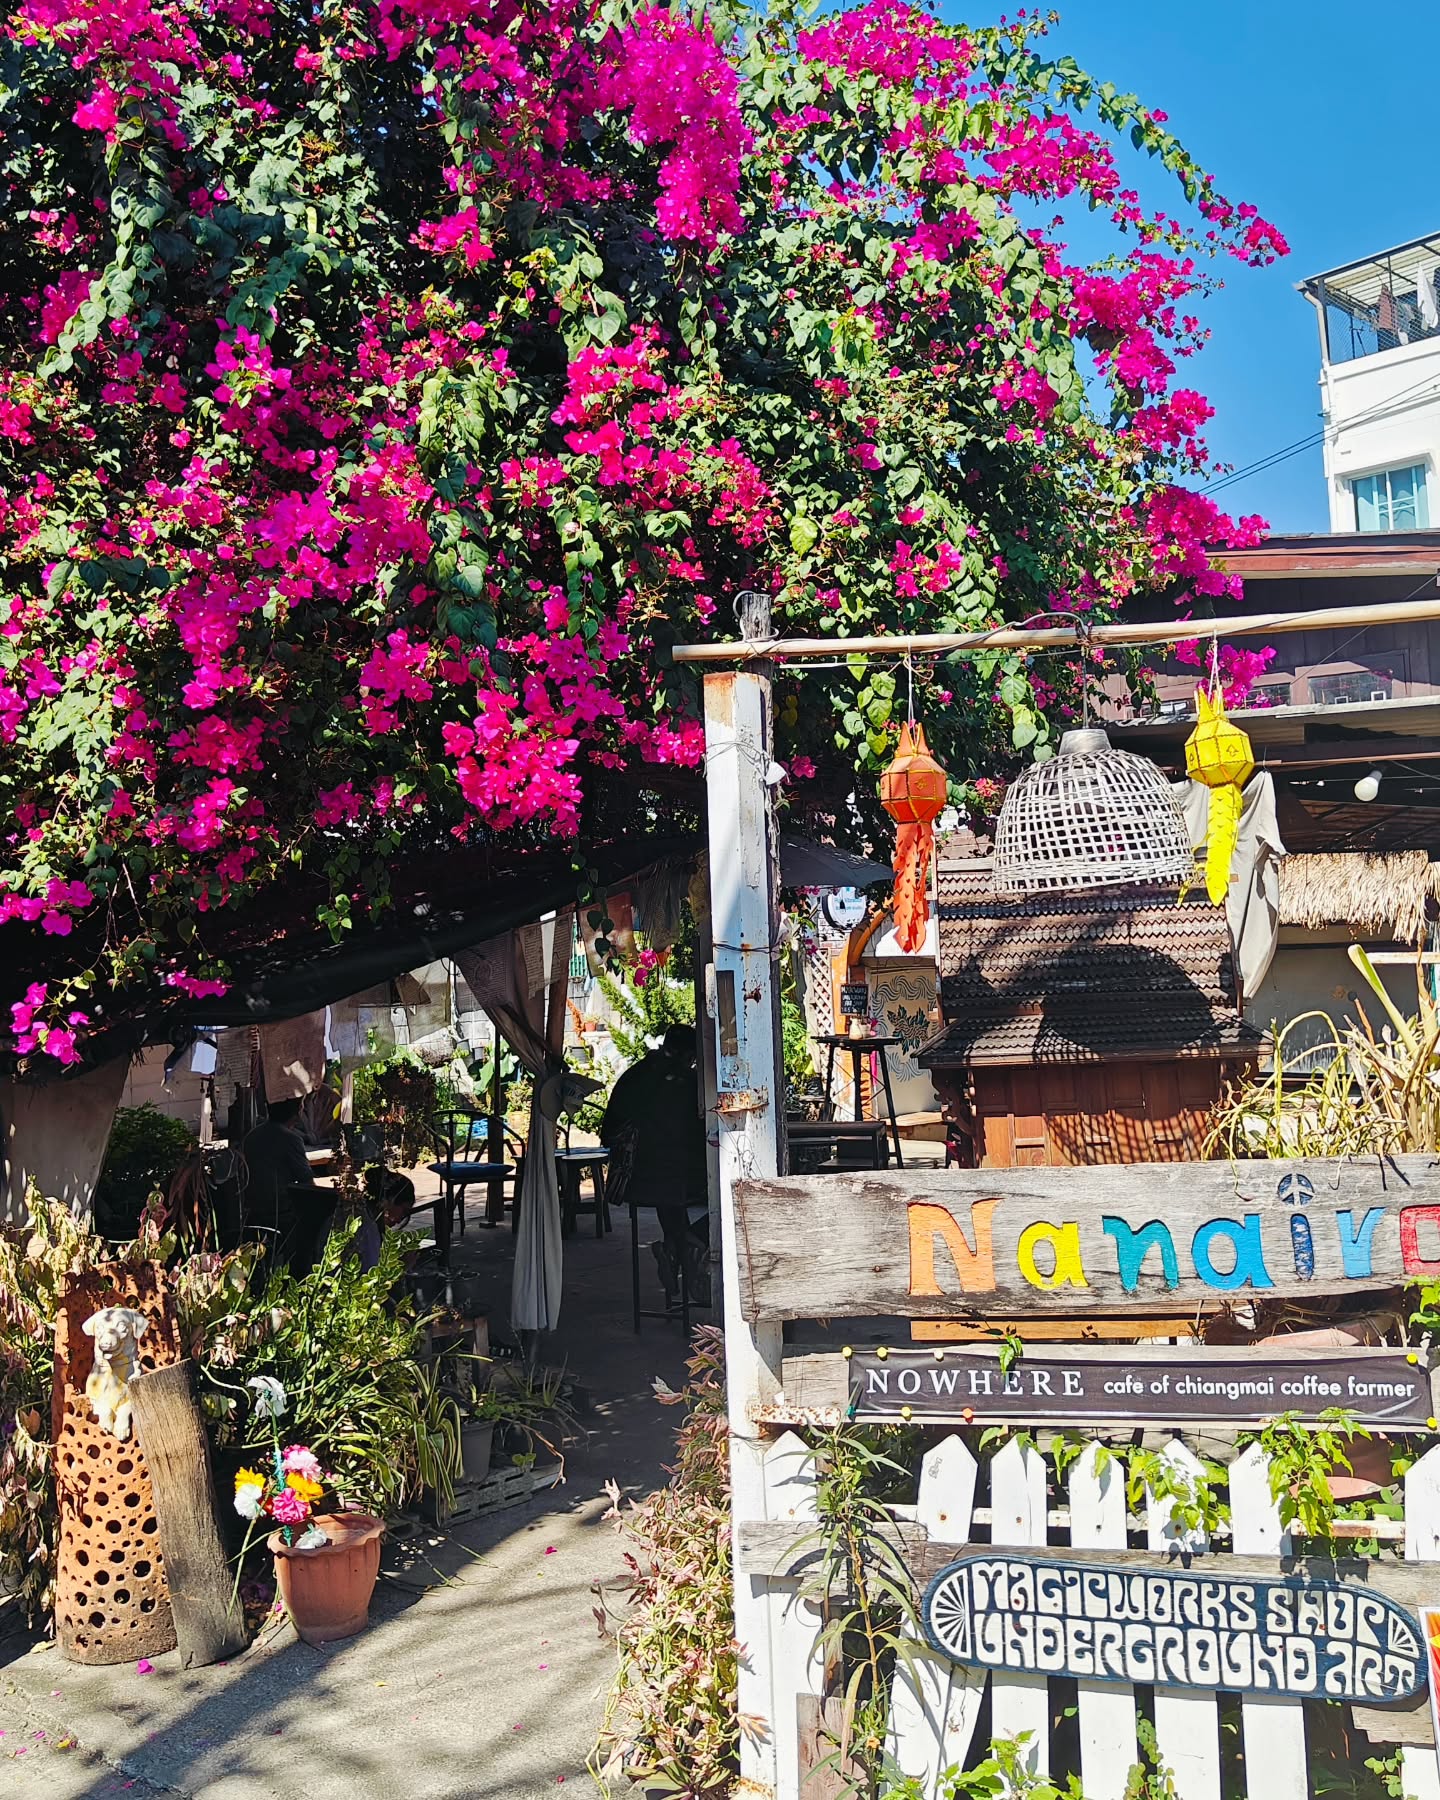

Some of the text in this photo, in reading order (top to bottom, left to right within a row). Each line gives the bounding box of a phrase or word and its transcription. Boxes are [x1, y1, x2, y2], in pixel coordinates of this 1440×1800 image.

[866, 1369, 1415, 1400] NOWHERE cafe of chiangmai coffee farmer
[971, 1561, 1389, 1646] MAGICWORKS SHOP
[974, 1612, 1416, 1696] UNDERGROUND ART
